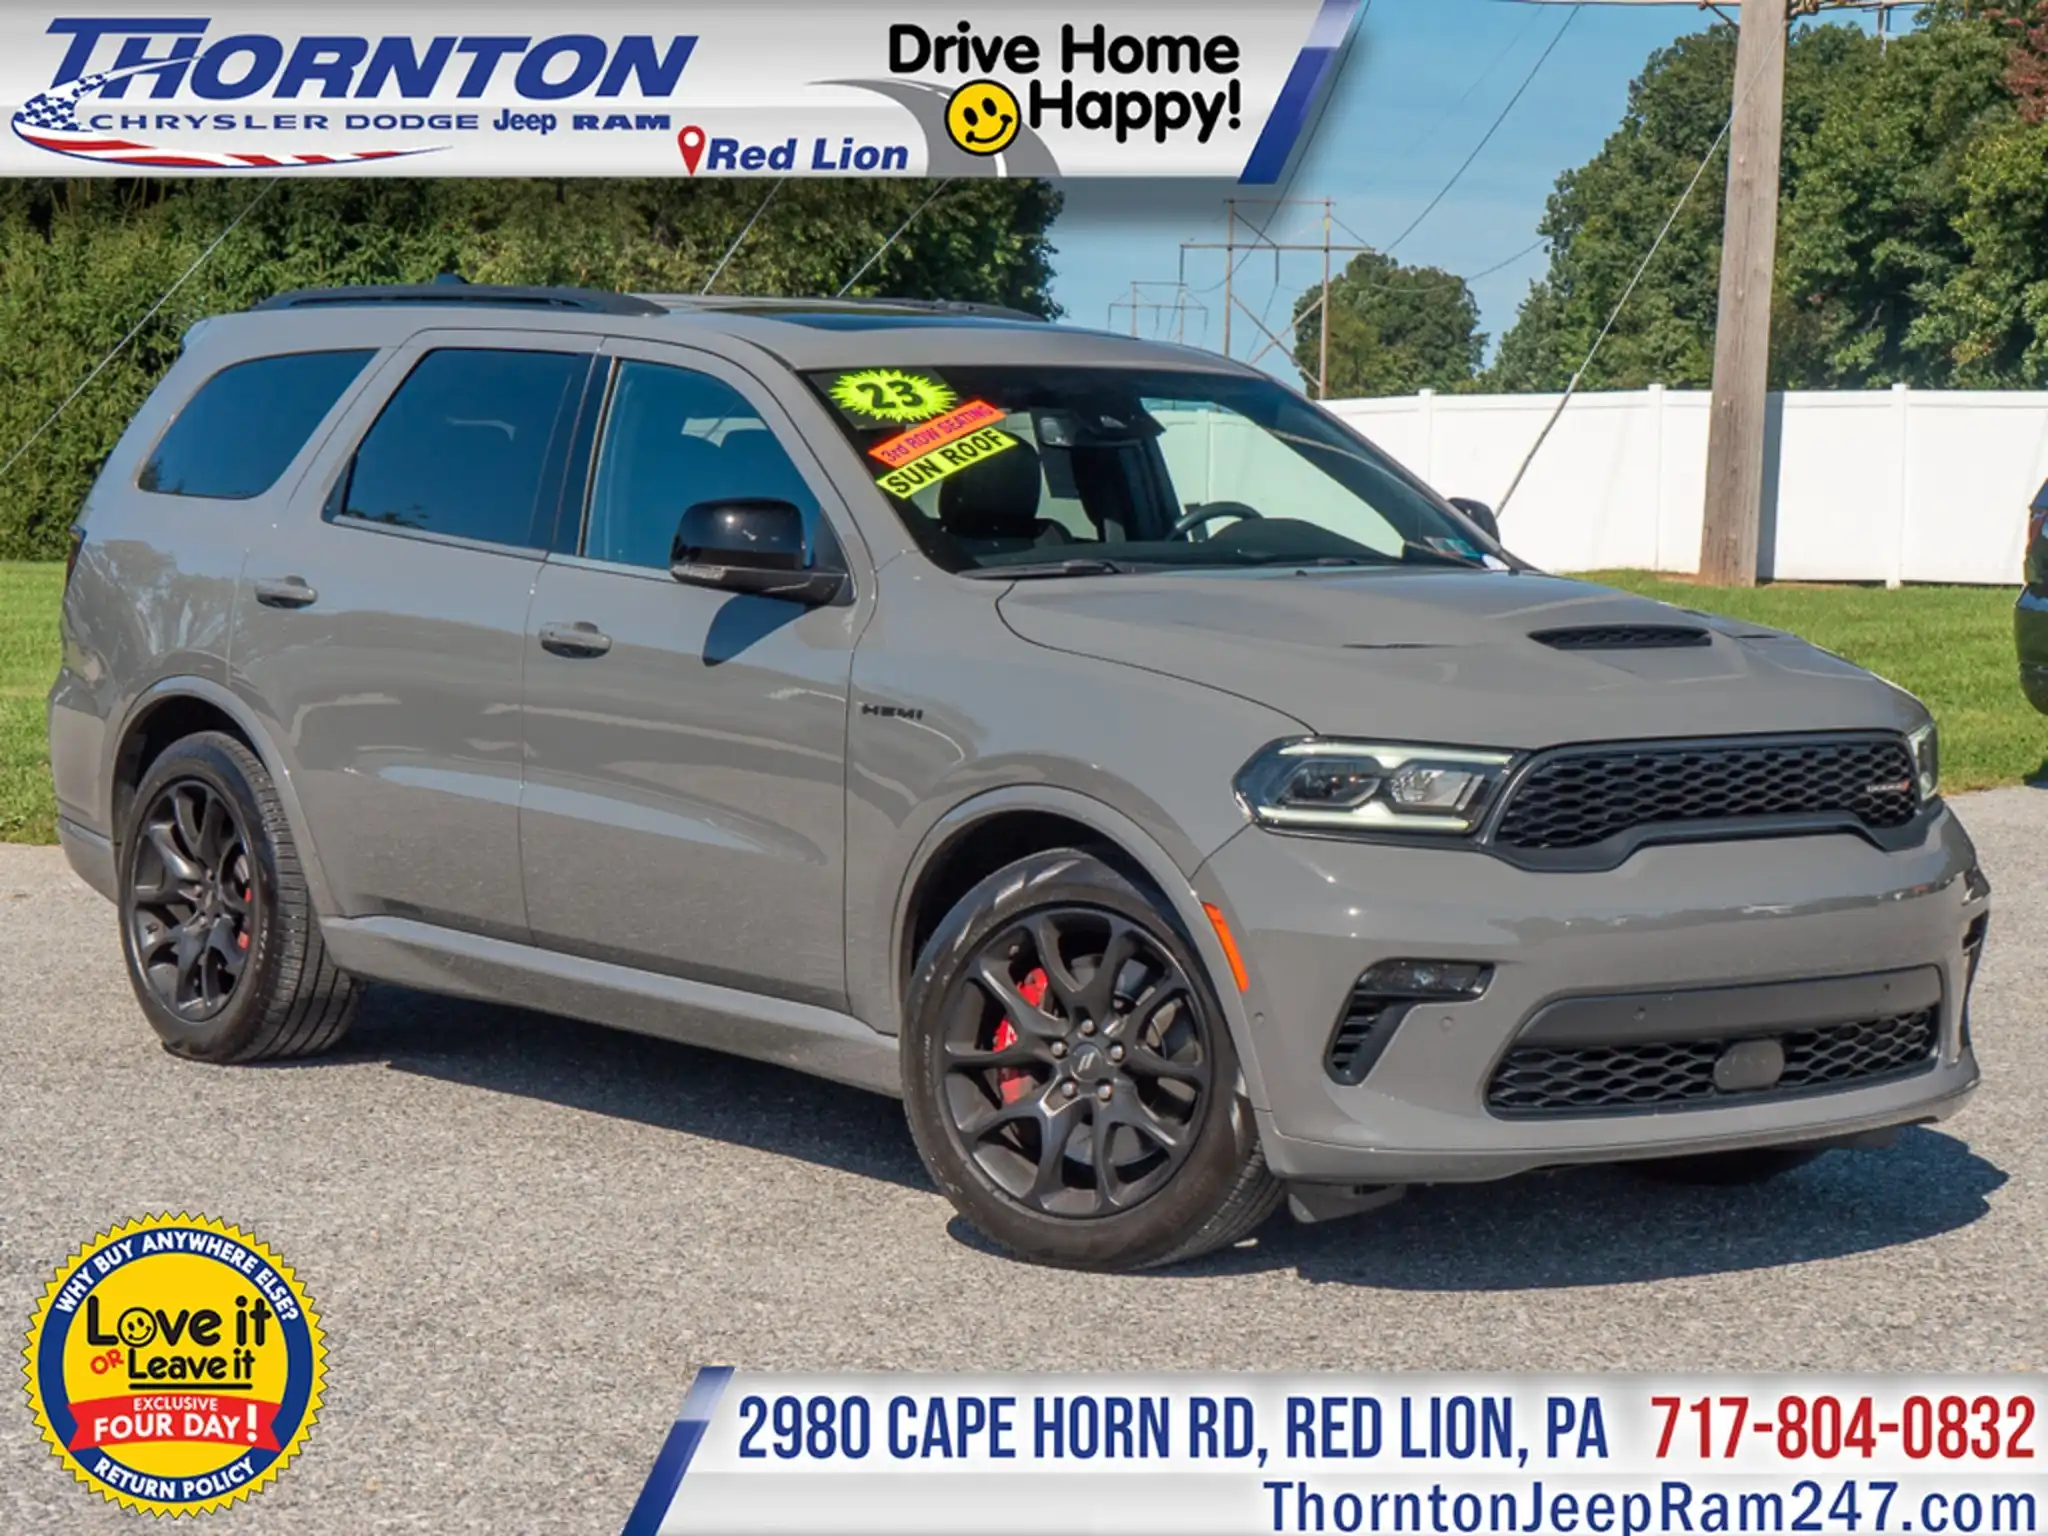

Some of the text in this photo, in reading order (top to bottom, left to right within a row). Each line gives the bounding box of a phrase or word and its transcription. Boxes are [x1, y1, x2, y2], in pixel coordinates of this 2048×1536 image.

[856, 380, 924, 409] 23
[905, 429, 940, 450] ROW
[937, 404, 994, 434] SEATING
[887, 430, 1004, 493] SUN ROOF
